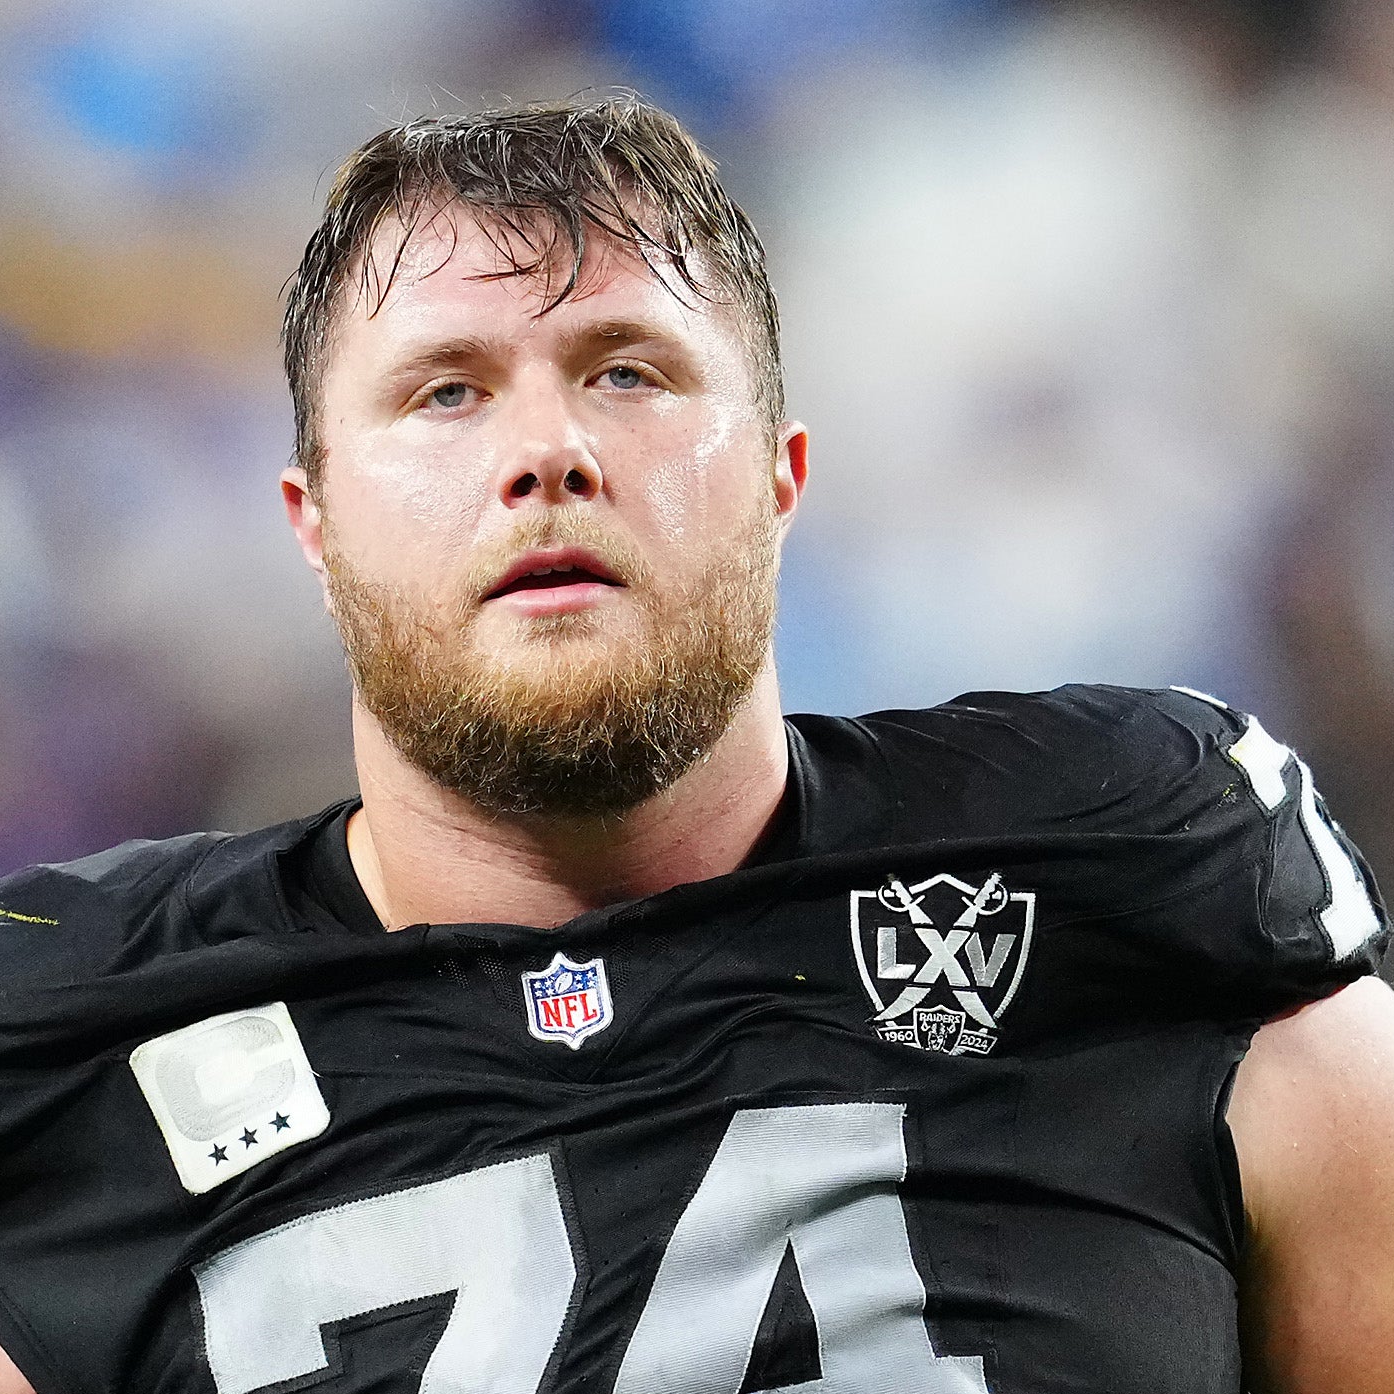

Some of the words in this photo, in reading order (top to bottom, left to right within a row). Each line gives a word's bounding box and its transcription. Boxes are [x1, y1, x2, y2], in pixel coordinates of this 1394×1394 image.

[877, 926, 1018, 988] LXV
[540, 992, 598, 1028] NFL
[919, 1012, 961, 1024] RAIDERS
[884, 1031, 914, 1043] 1960
[960, 1035, 989, 1050] 2024
[155, 1015, 296, 1142] C
